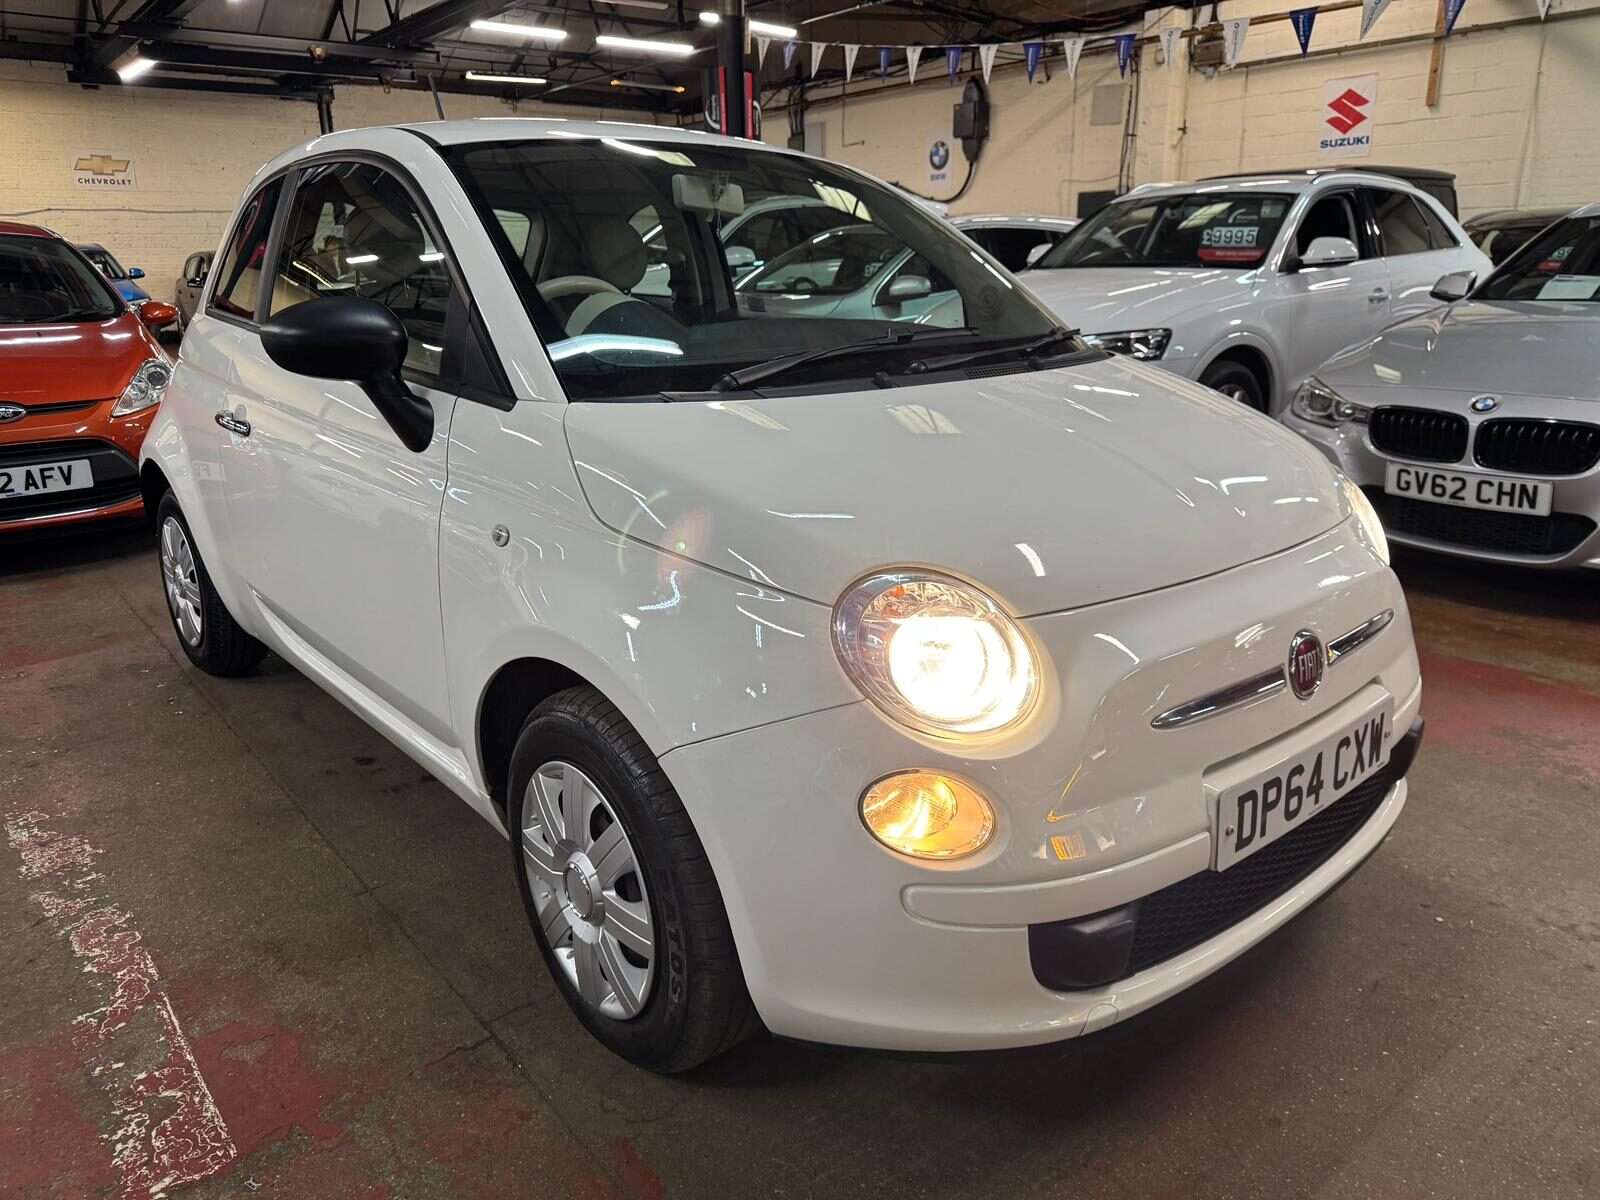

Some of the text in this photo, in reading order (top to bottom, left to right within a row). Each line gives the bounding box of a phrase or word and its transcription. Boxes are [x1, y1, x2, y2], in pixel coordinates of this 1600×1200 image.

[1320, 136, 1369, 149] SUZUKI
[1201, 229, 1256, 245] £9995
[24, 465, 72, 491] AFV
[1396, 469, 1538, 509] GV62 CHN
[1298, 650, 1319, 683] FIAT
[1235, 712, 1384, 852] DP64 CXW
